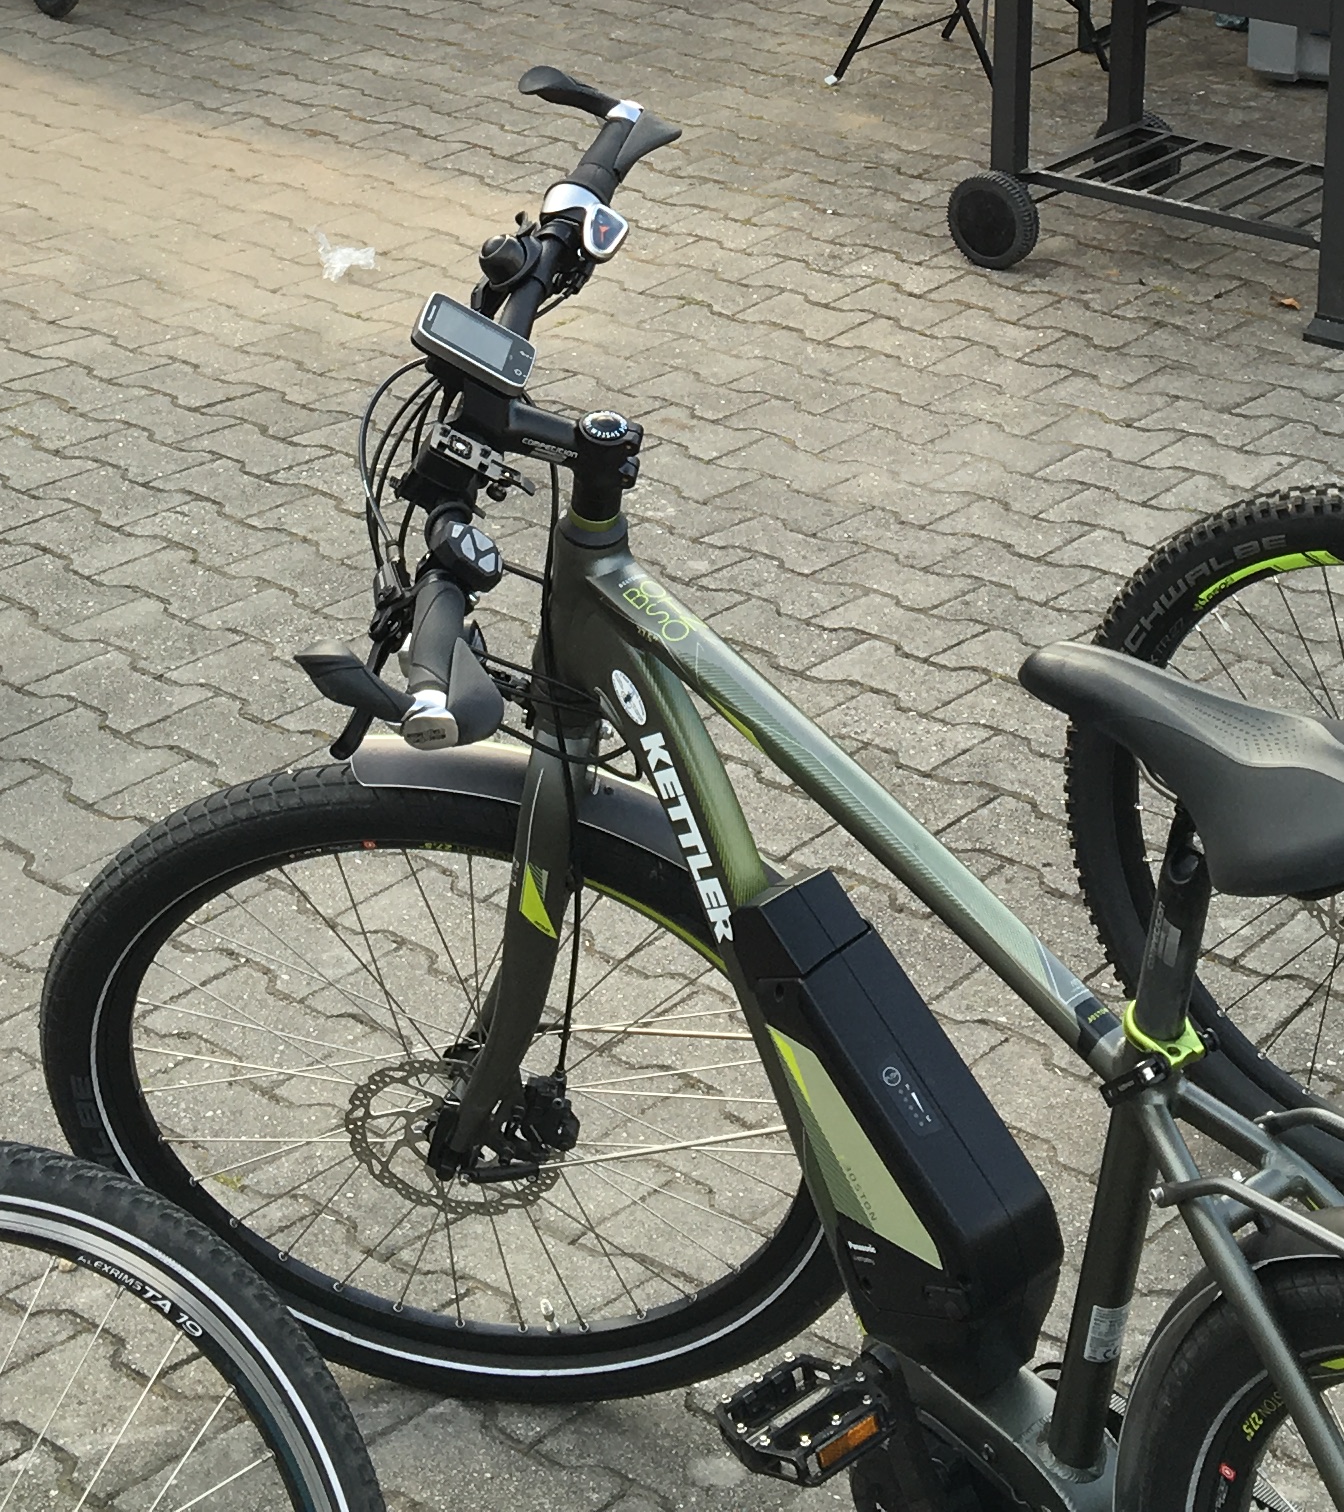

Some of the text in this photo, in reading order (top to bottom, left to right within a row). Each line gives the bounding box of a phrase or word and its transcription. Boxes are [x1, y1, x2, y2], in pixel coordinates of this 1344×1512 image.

[1119, 532, 1288, 654] CHWALBE
[639, 732, 733, 944] KETTLER
[139, 1287, 172, 1315] TA
[175, 1311, 204, 1338] 19
